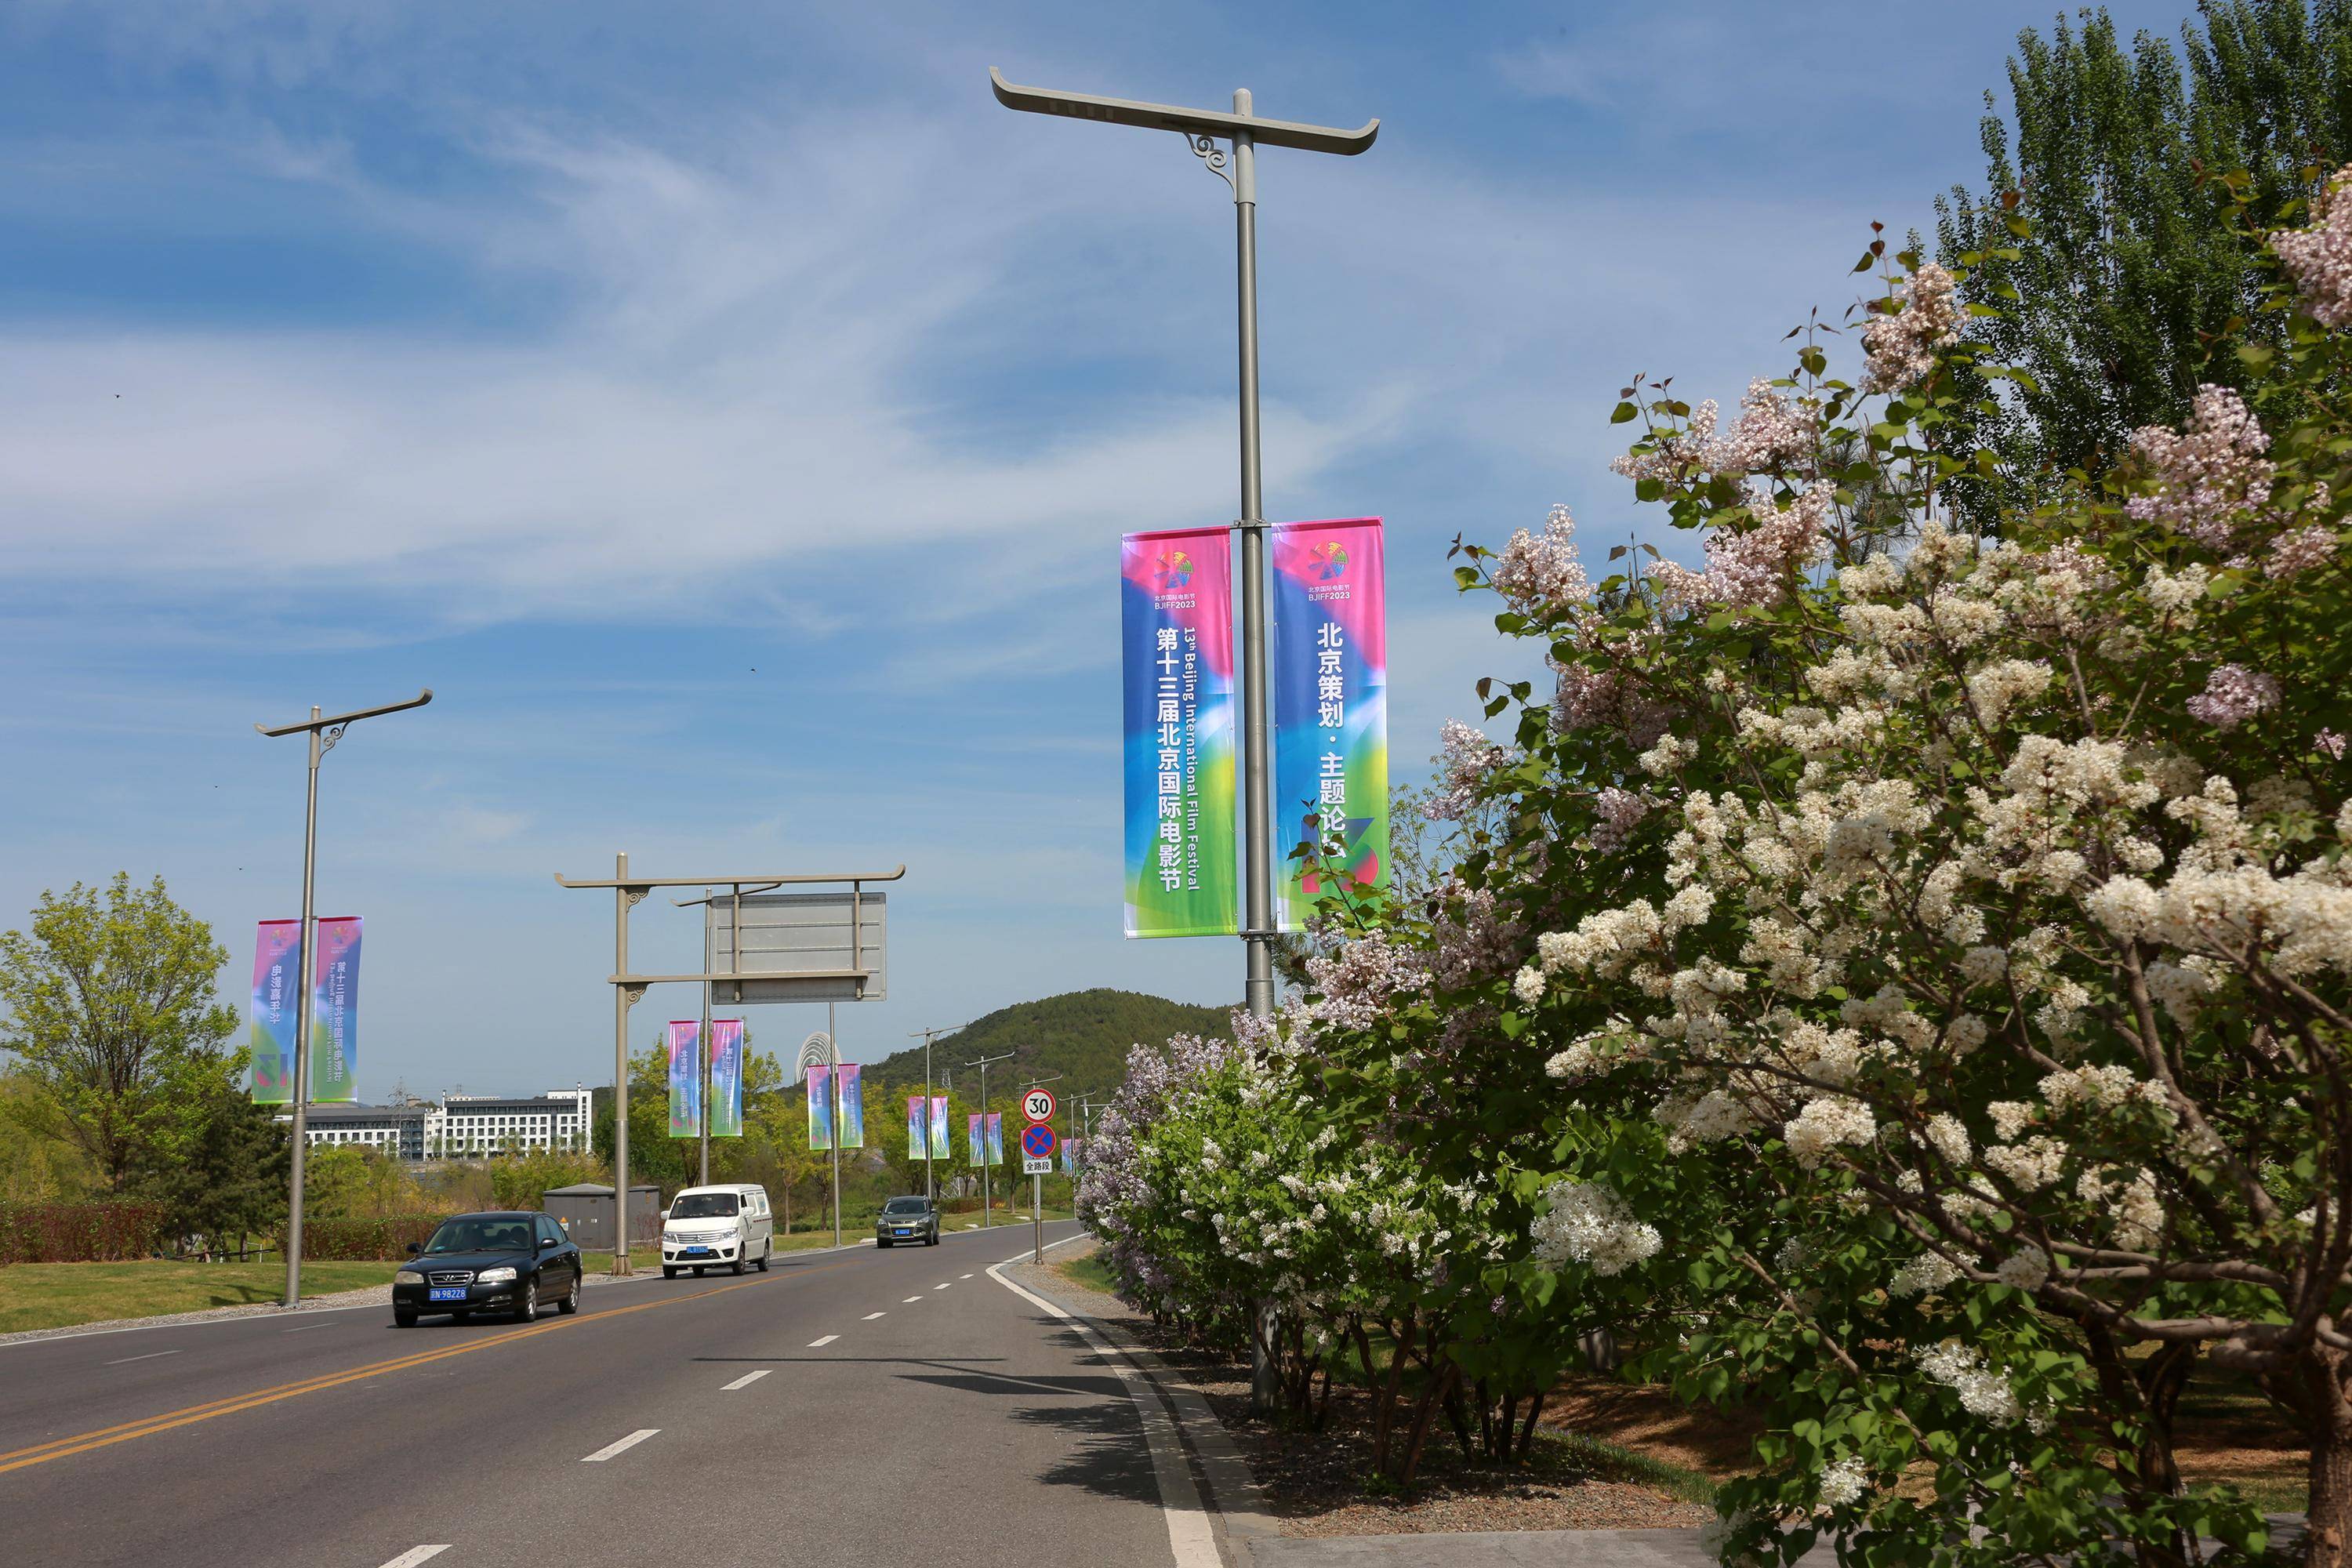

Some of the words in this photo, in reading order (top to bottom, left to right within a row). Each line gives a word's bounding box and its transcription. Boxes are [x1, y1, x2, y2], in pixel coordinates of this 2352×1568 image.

[1155, 593, 1196, 602] 北京国际电影节
[1308, 584, 1350, 593] 北京国际电影节
[1308, 591, 1350, 601] BJIFF2023
[1155, 600, 1196, 610] BJIFF2023
[1185, 626, 1196, 651] 13th
[1183, 653, 1196, 701] Beijing
[1156, 626, 1181, 893] 第十三届北京国际电影节
[1185, 705, 1199, 797] International
[1187, 800, 1199, 831] Film
[1188, 835, 1200, 891] Festival
[1029, 1098, 1049, 1114] 30
[1026, 1162, 1050, 1171] 全路段
